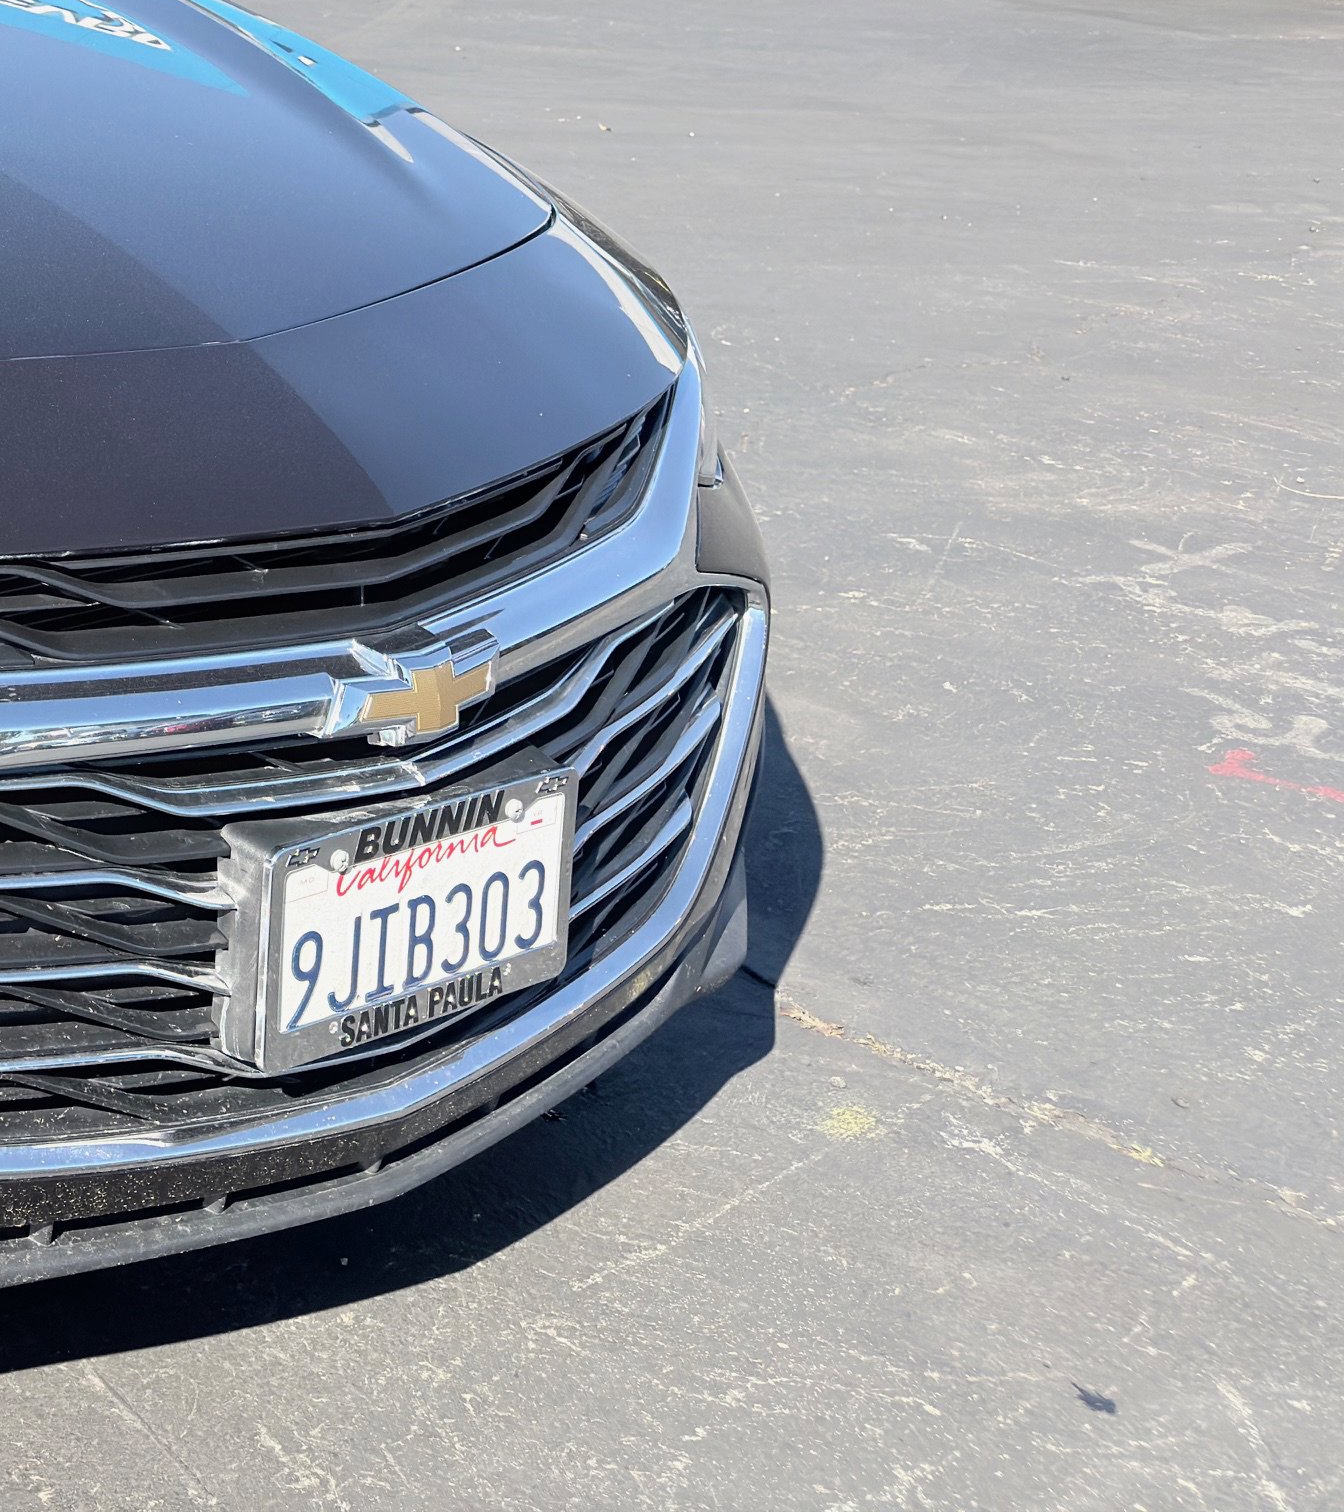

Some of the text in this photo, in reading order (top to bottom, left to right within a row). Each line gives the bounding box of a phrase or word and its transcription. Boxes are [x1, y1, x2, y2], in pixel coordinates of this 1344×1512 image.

[336, 825, 516, 896] California
[353, 789, 505, 864] BUNNIN
[286, 859, 545, 1029] 9JIB303
[340, 966, 503, 1047] SANTA PAULA
